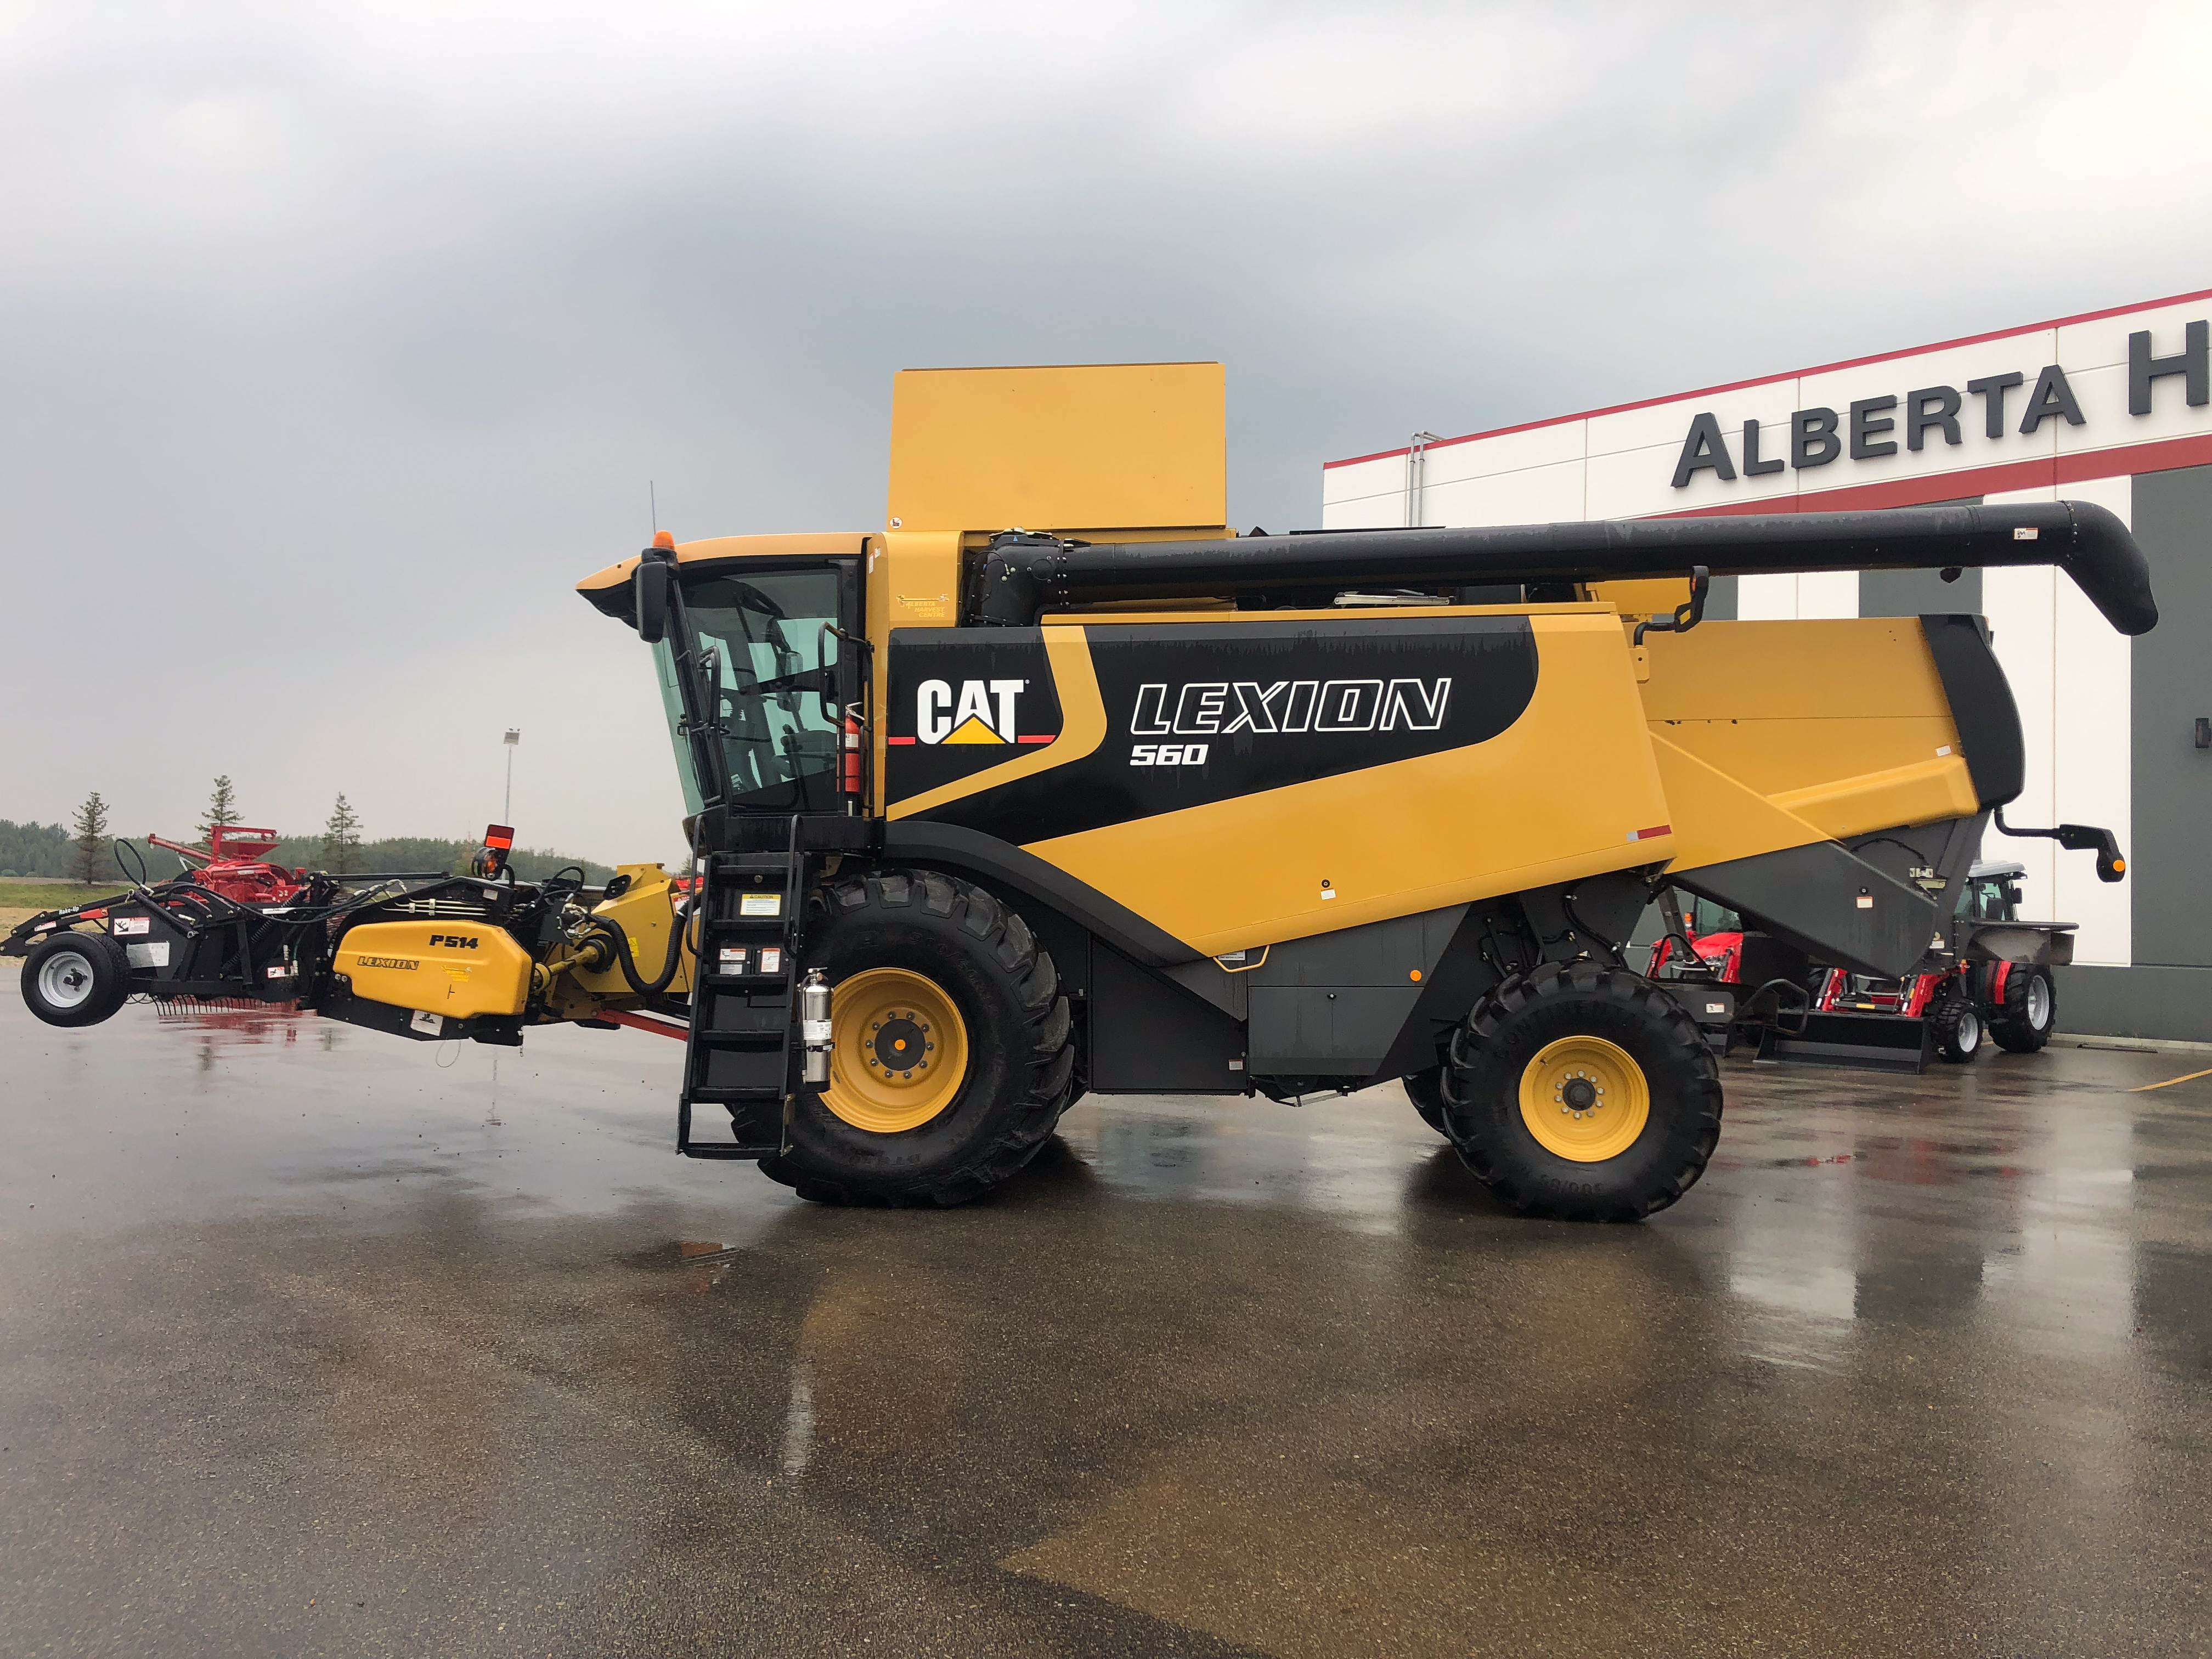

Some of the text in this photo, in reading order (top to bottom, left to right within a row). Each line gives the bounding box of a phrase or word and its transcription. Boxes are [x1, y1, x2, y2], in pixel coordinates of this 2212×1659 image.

[1671, 319, 2210, 488] ALBERTA H
[917, 679, 1024, 744] CAT
[1130, 678, 1452, 735] LEXION
[1130, 744, 1209, 766] 560
[428, 934, 479, 949] P514
[357, 956, 420, 970] LEXION
